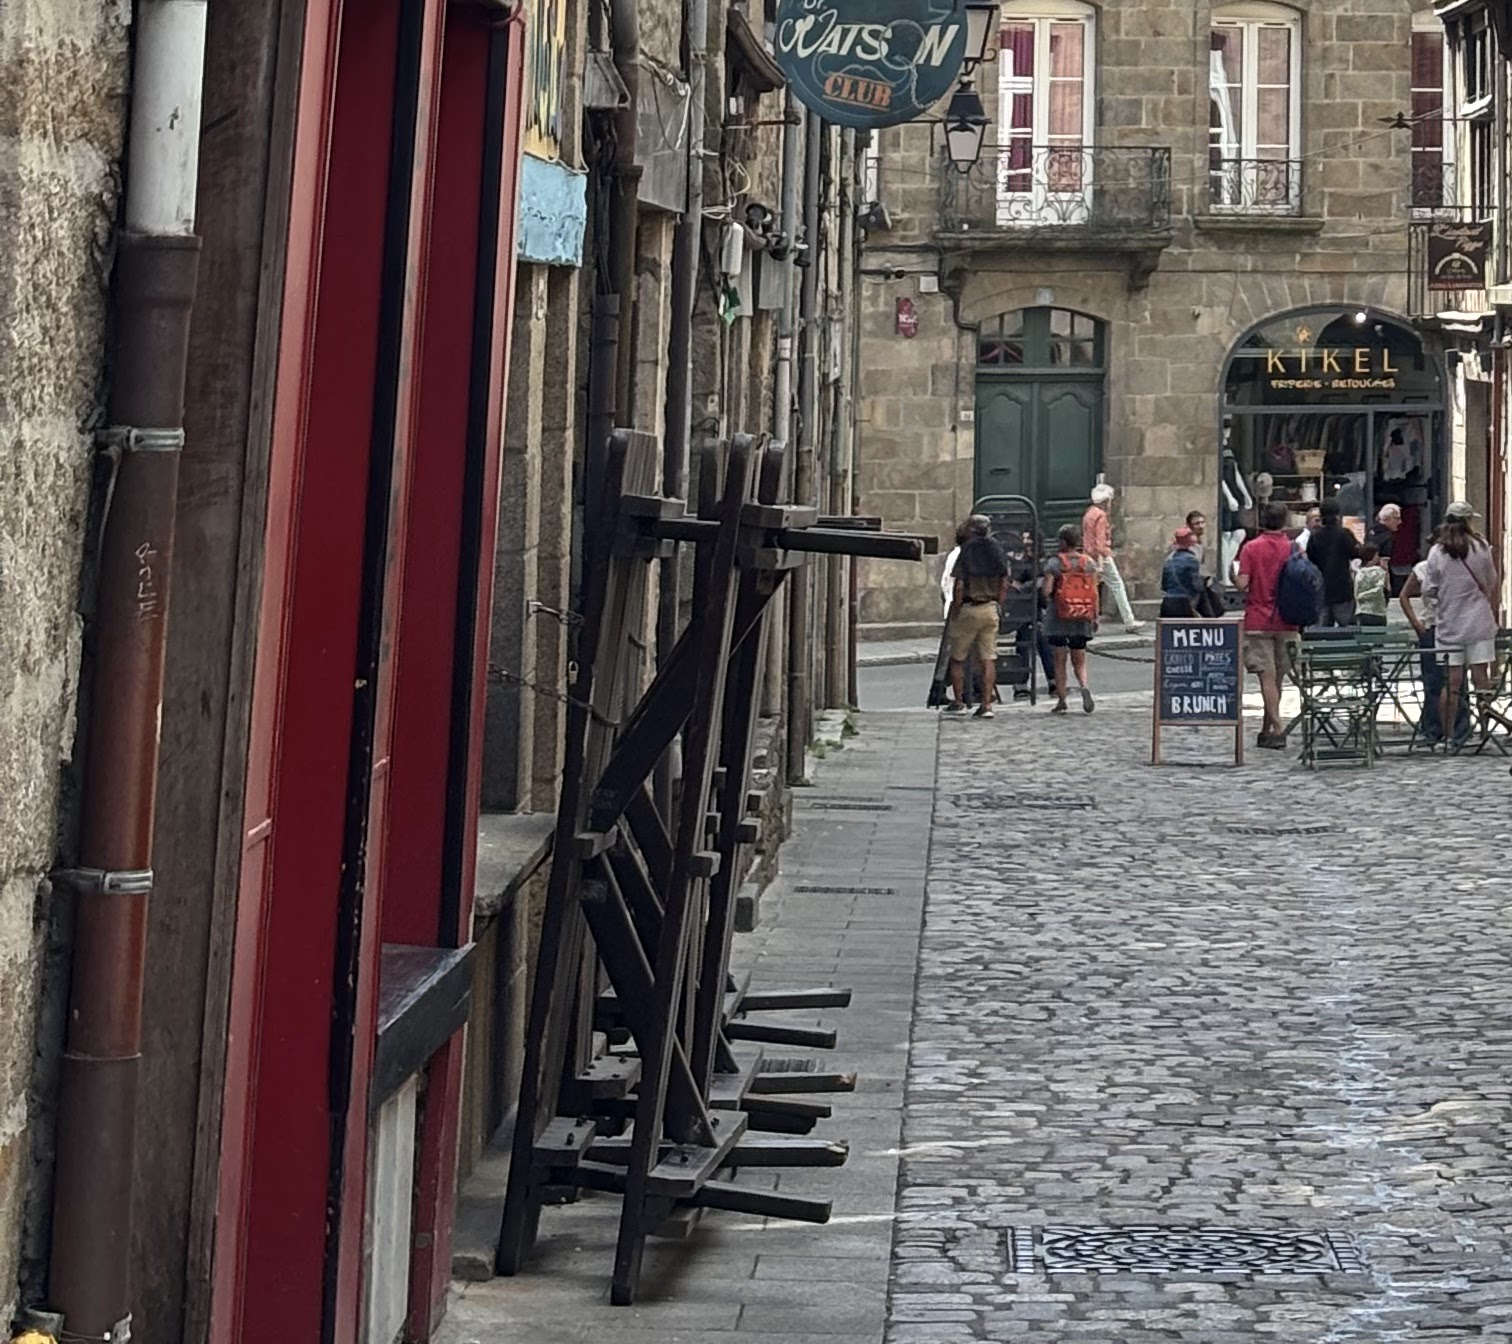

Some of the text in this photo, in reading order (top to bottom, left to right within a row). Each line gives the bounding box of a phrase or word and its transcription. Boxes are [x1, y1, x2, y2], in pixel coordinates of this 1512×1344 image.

[823, 73, 892, 108] CLUB
[1266, 347, 1399, 374] KIKEL
[1173, 627, 1224, 647] MENU
[1171, 694, 1227, 714] BRUNCH
